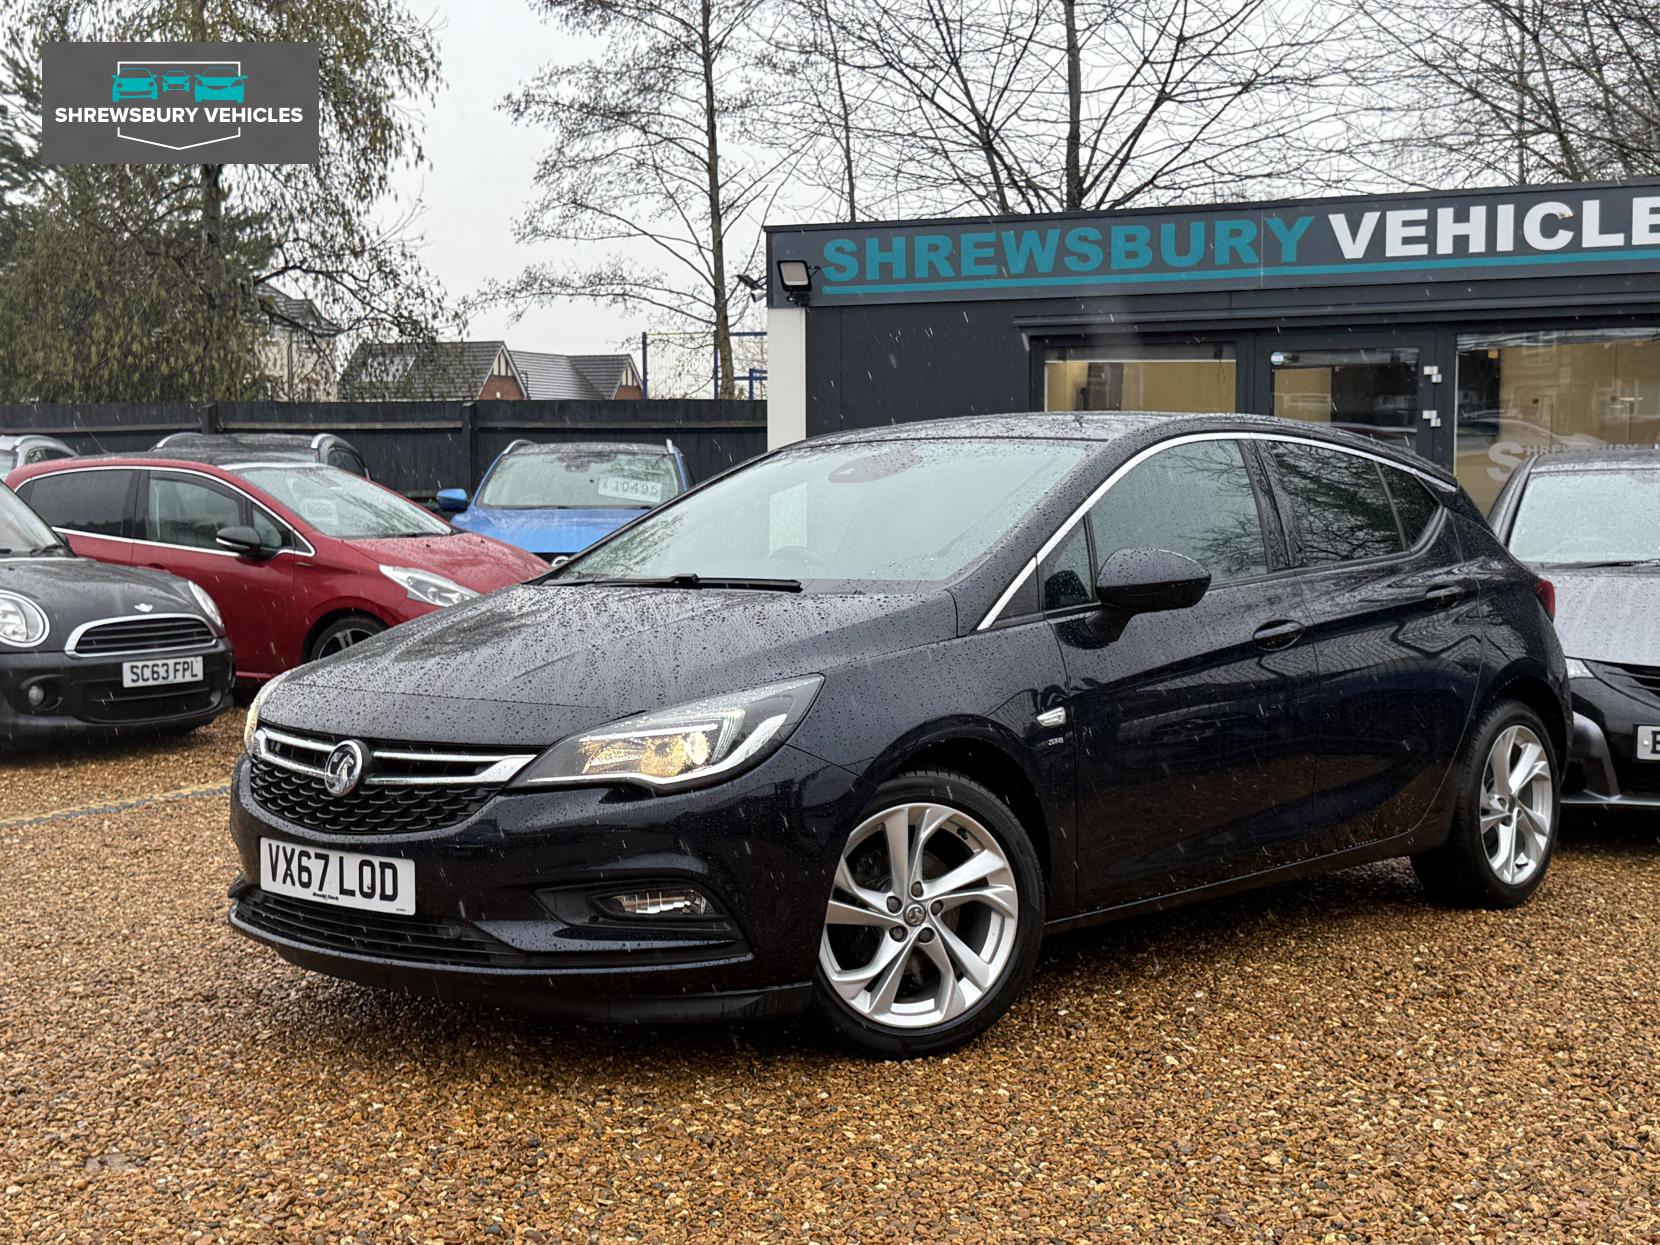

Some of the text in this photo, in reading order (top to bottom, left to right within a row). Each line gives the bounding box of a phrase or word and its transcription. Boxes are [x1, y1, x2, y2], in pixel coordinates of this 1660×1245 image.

[822, 197, 1660, 282] SHREWSBURY VEHICLE
[130, 660, 198, 683] SC63 FPL
[268, 843, 398, 902] VX67 LOD
